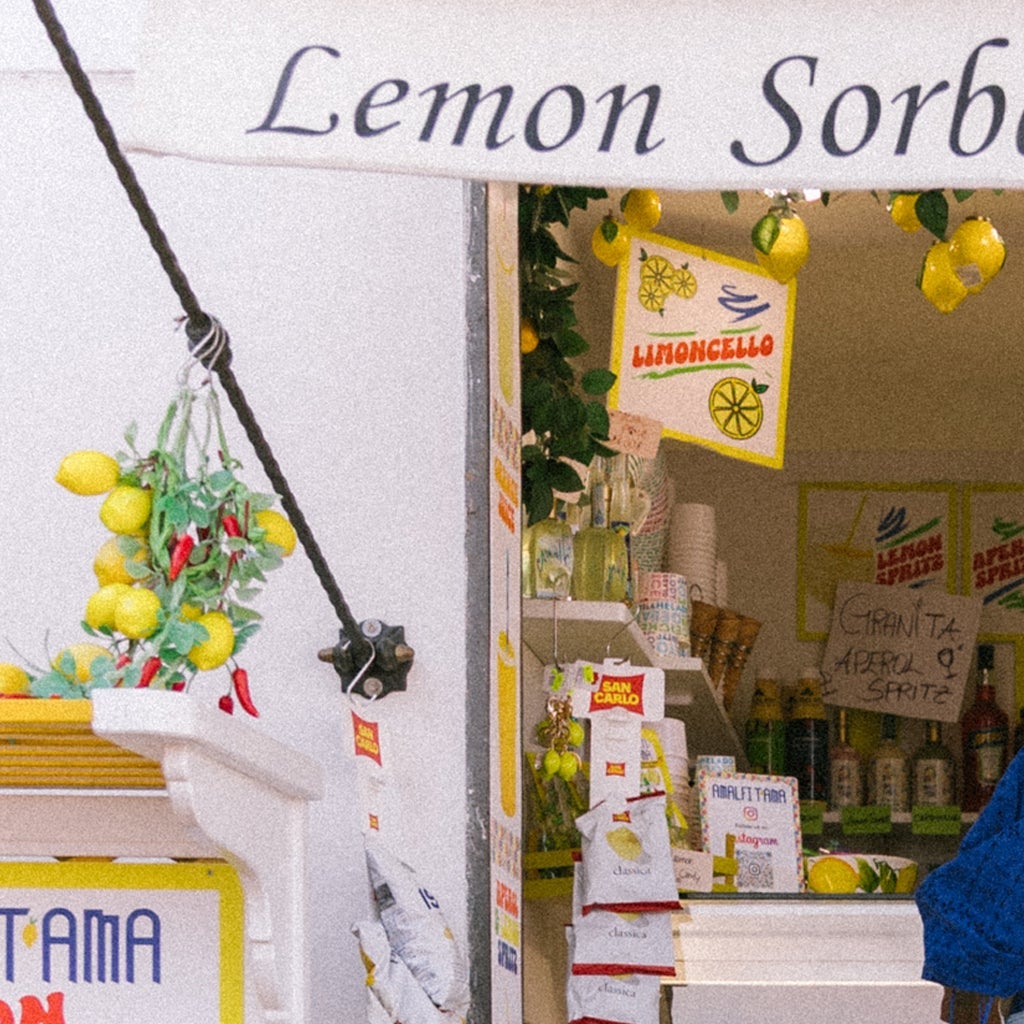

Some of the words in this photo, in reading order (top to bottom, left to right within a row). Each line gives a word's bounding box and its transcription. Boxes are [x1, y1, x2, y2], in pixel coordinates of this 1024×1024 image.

[246, 45, 665, 154] Lemon
[632, 333, 774, 368] LIMONCELLO
[877, 533, 943, 570] LEMON
[835, 647, 924, 676] APEROL
[593, 692, 640, 706] CARLO
[602, 681, 632, 694] SAN
[856, 678, 953, 705] SPRITZ
[608, 926, 647, 939] classica
[598, 982, 636, 998] classica
